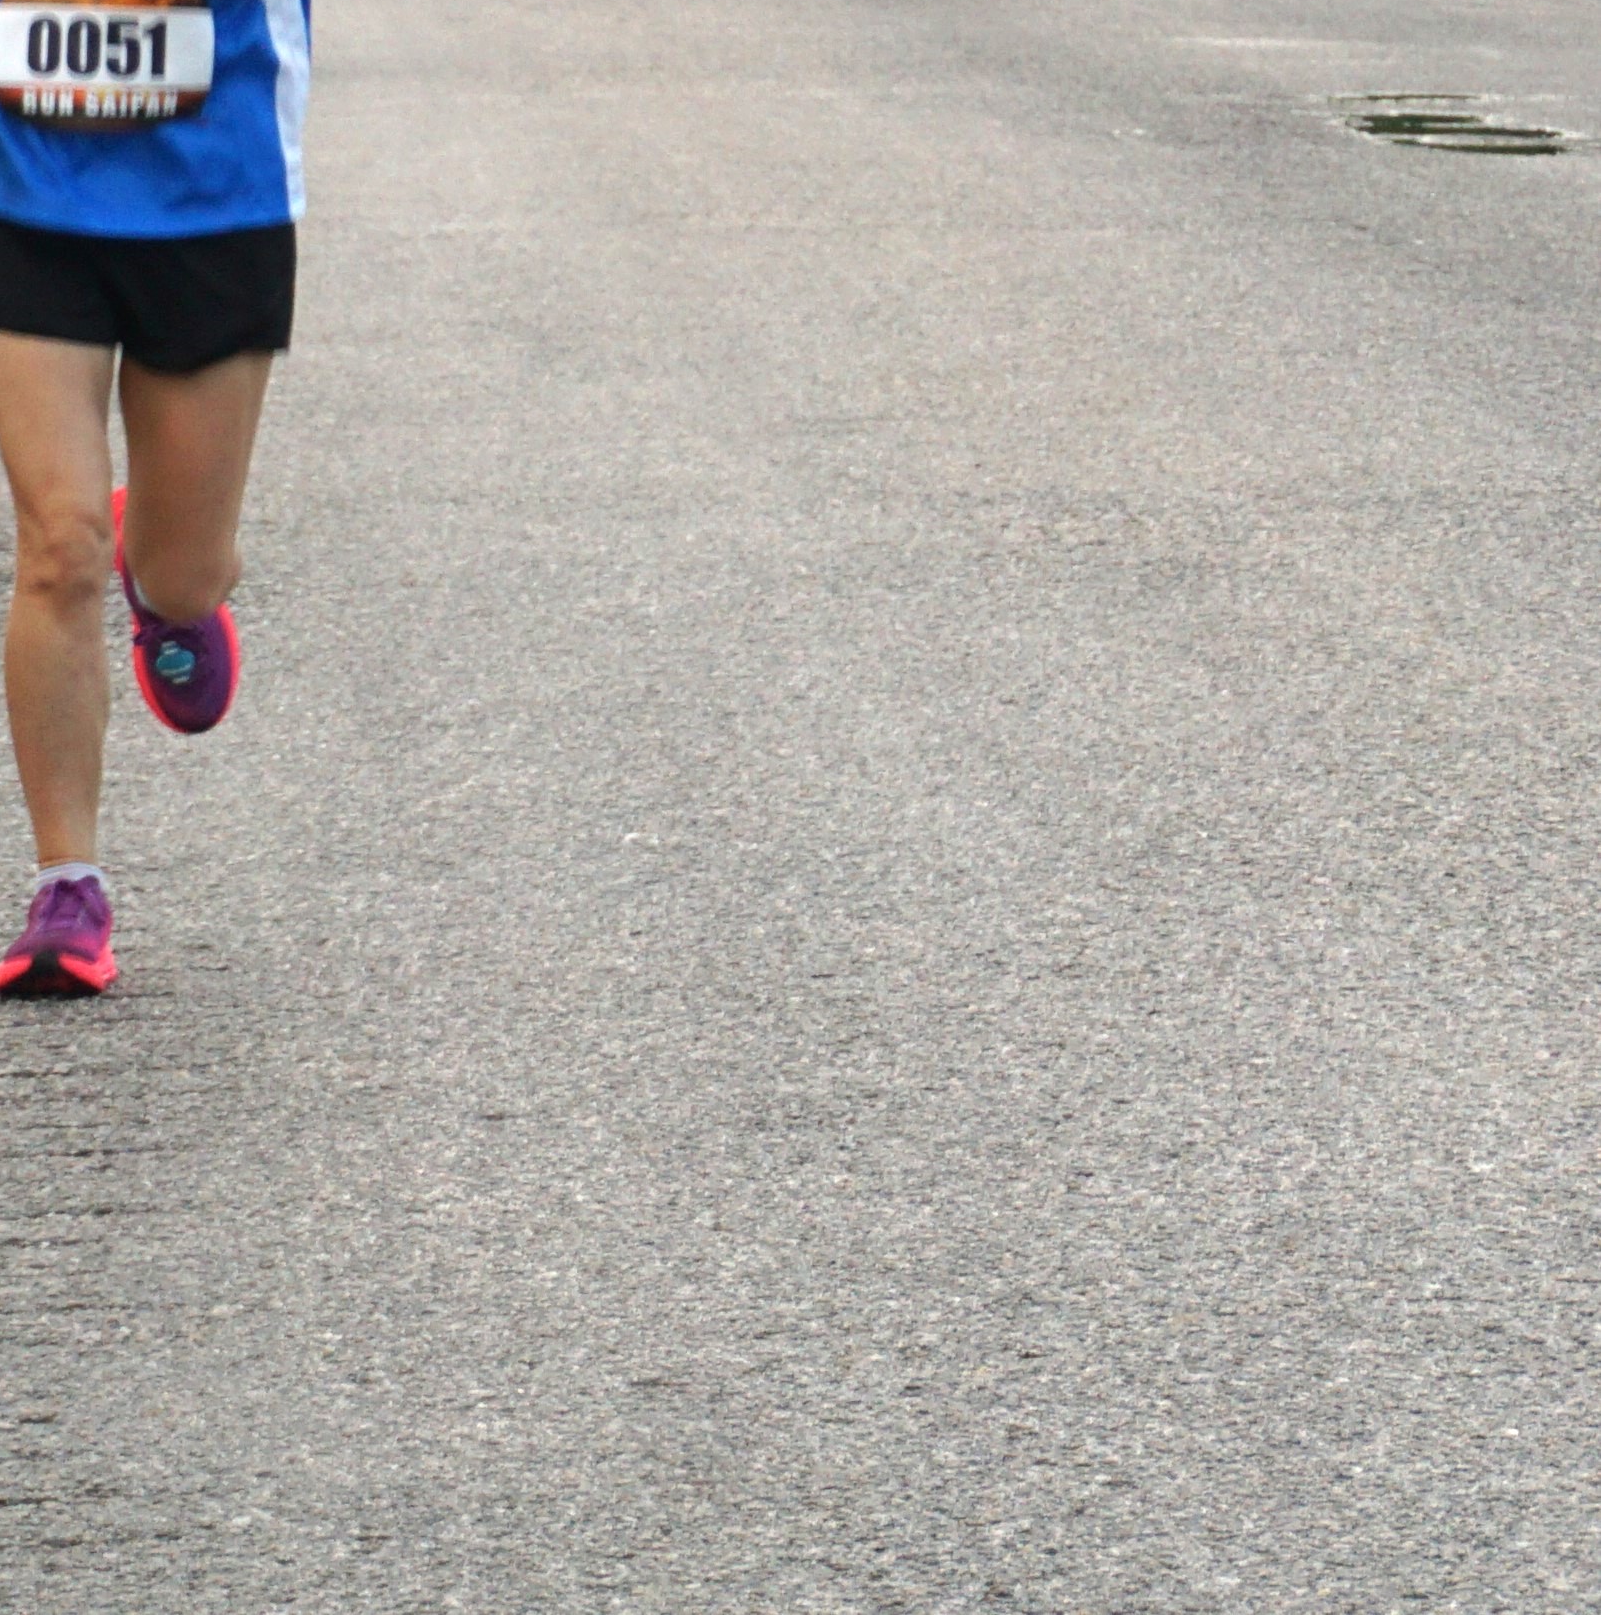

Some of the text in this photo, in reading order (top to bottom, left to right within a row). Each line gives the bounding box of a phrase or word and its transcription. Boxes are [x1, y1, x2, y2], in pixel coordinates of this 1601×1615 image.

[26, 14, 167, 79] 0051
[23, 87, 178, 118] RUN SAIPAN
